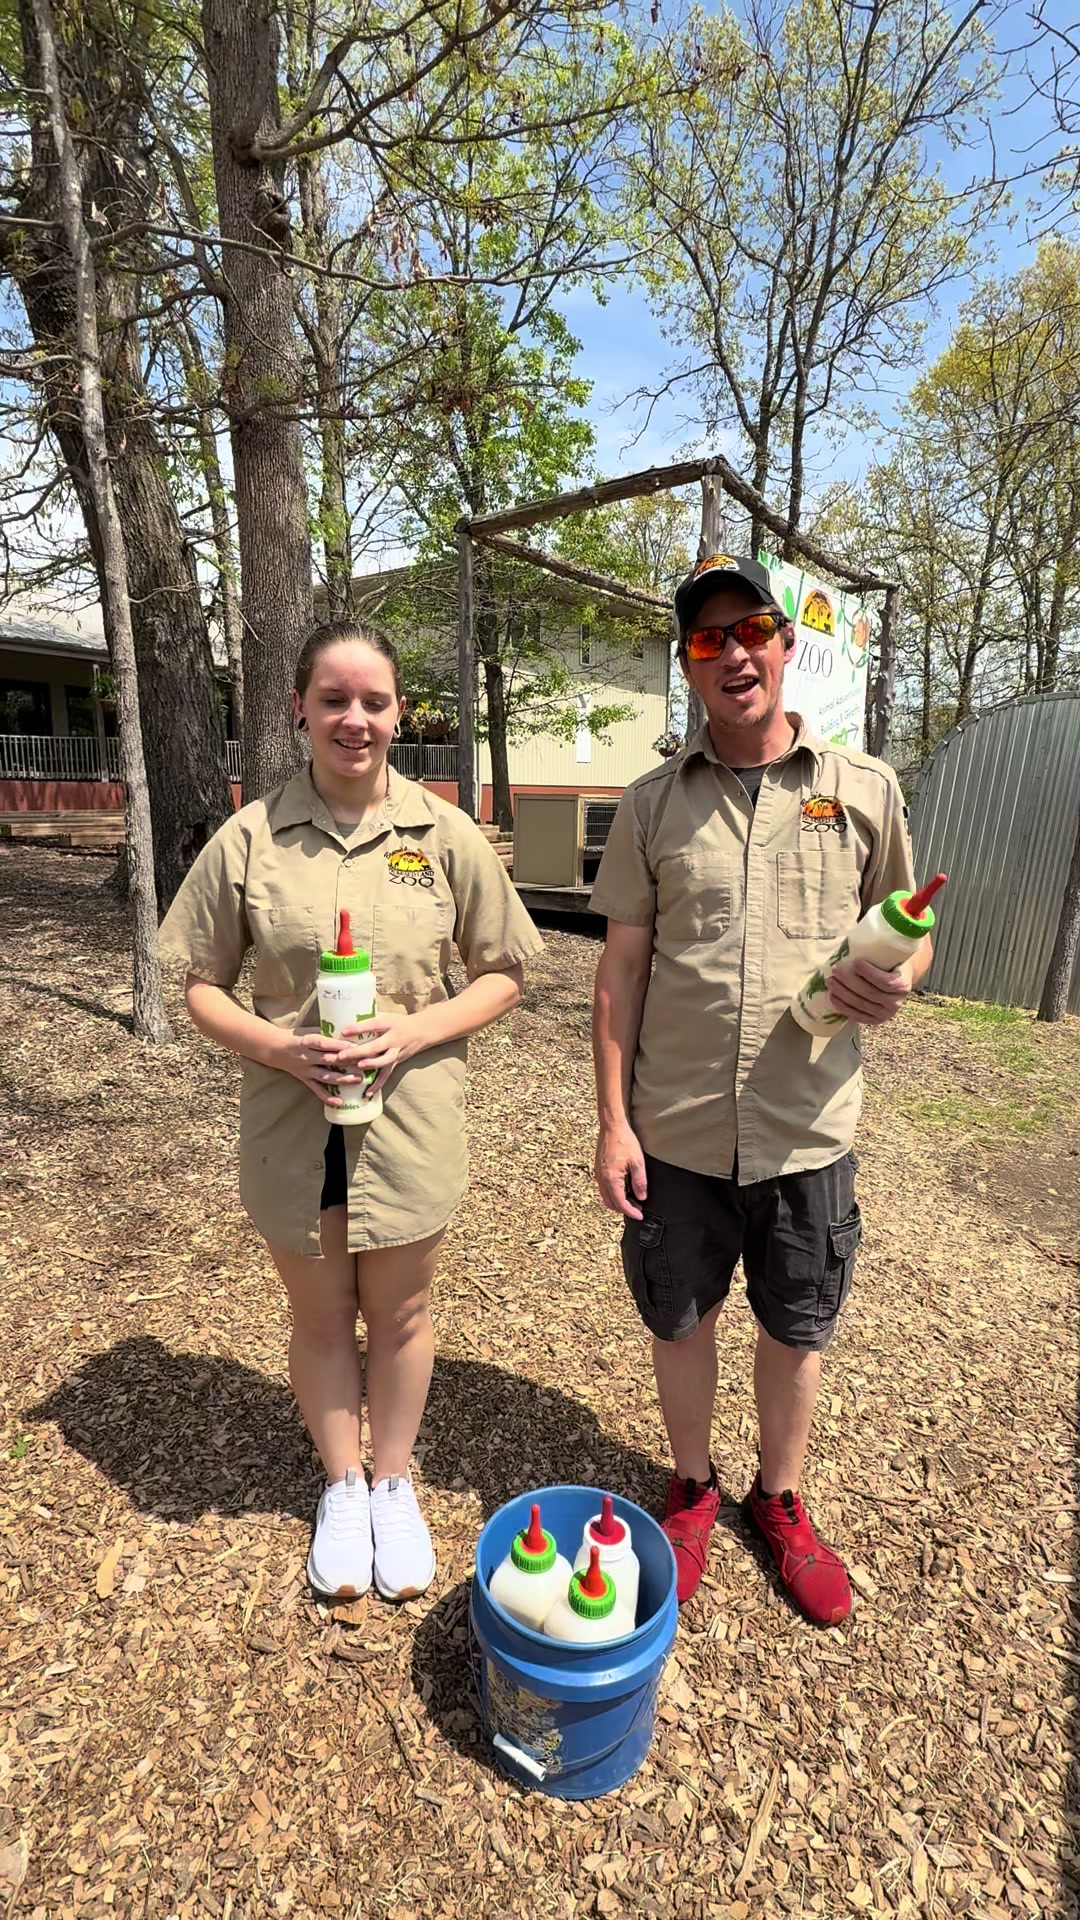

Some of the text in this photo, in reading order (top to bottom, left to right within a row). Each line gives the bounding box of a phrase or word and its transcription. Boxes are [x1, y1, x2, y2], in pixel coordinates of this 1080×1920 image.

[797, 639, 833, 678] ZOO
[801, 821, 848, 833] ZOO
[388, 872, 435, 888] ZOO
